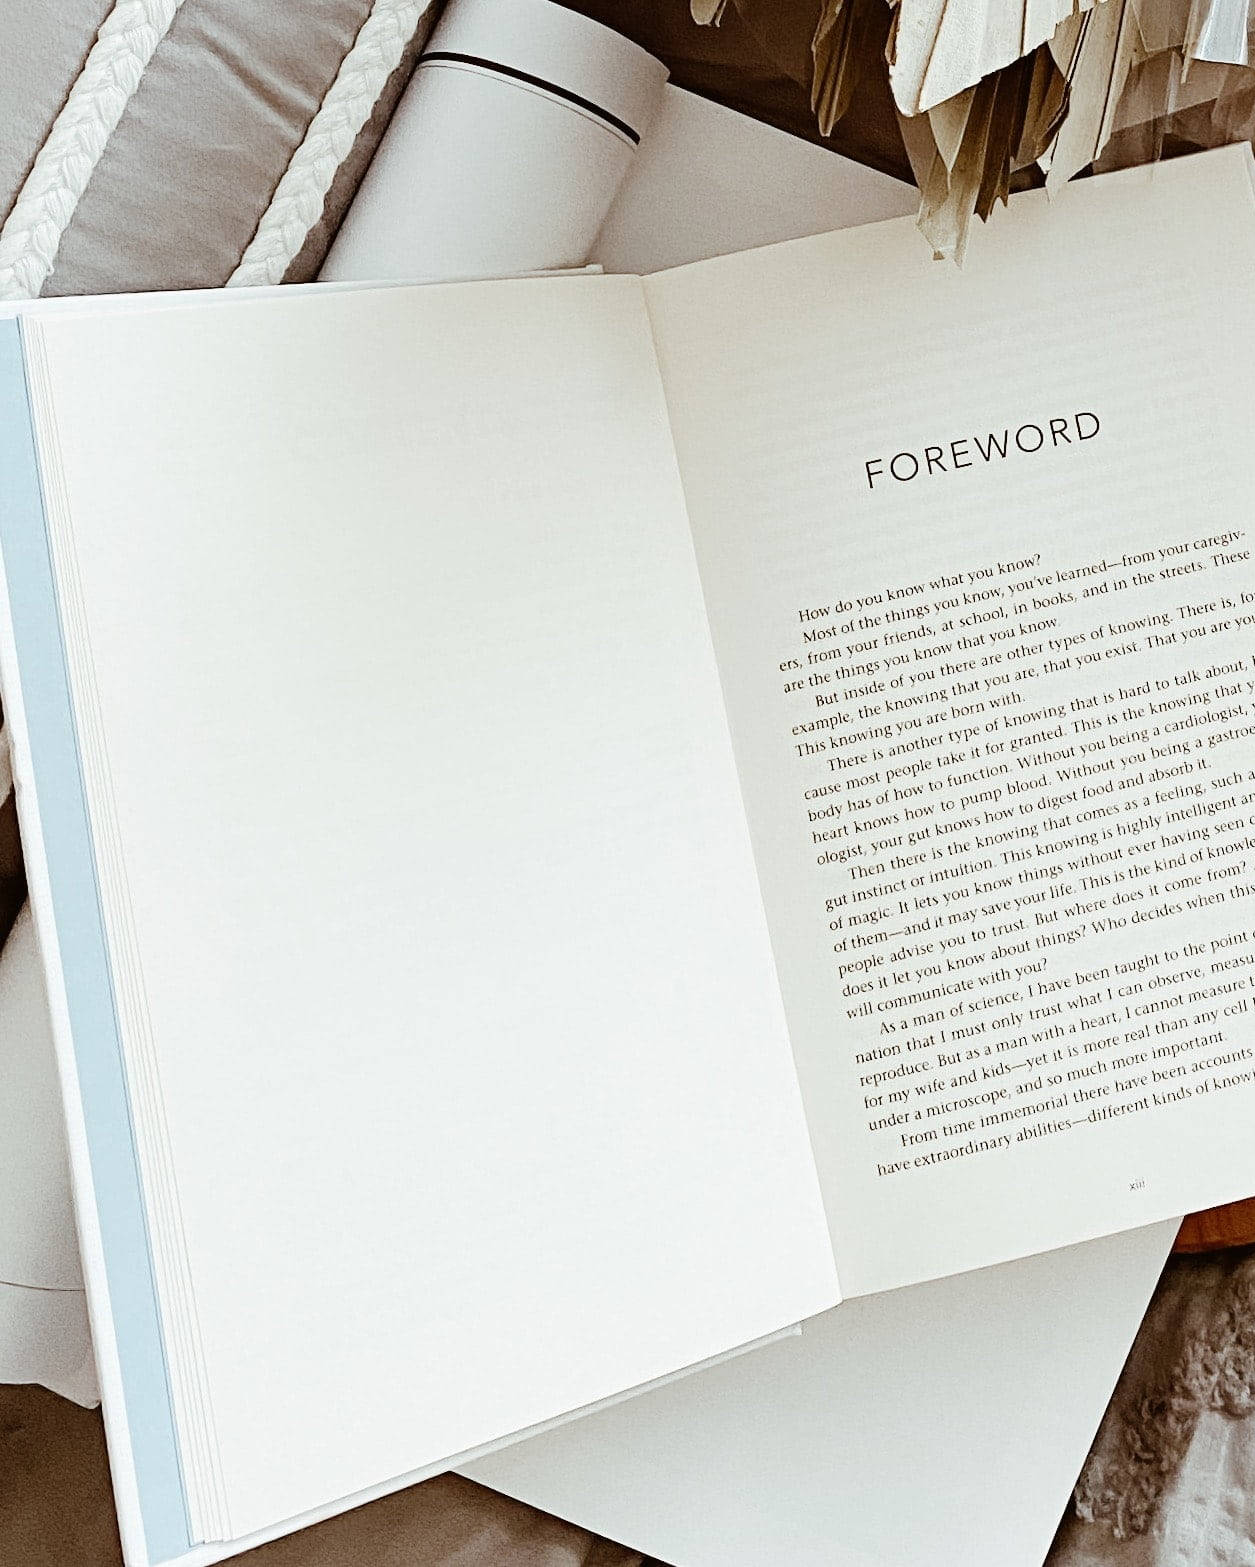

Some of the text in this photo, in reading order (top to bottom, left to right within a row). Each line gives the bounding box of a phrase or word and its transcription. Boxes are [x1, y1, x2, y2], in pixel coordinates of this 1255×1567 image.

[865, 412, 1100, 488] FOREWORD
[798, 553, 1041, 624] How do you know what you know?
[807, 647, 843, 666] from
[845, 638, 880, 660] your
[940, 619, 955, 633] at
[1012, 601, 1030, 616] in
[1081, 580, 1110, 599] and
[1112, 576, 1129, 592] in
[1128, 571, 1156, 587] the
[1209, 550, 1251, 568] These
[814, 690, 840, 712] But
[842, 680, 887, 701] inside
[890, 673, 906, 690] of
[908, 669, 936, 689] you
[939, 658, 977, 677] there
[980, 653, 1003, 667] are
[1006, 640, 1046, 662] other
[1048, 633, 1088, 654] types
[1090, 625, 1105, 641] of
[1175, 601, 1218, 620] There
[794, 738, 827, 758] This
[828, 725, 894, 751] knowing
[895, 717, 923, 737] you
[926, 711, 948, 726] are
[950, 701, 986, 720] born
[804, 782, 843, 801] cause
[845, 771, 882, 792] most
[885, 758, 933, 785] people
[936, 751, 967, 769] take
[969, 746, 982, 760] it
[985, 739, 1005, 756] for
[1070, 717, 1103, 737] This
[1105, 712, 1119, 726] is
[1121, 706, 1146, 723] the
[1148, 688, 1212, 717] knowing
[1214, 682, 1244, 699] that
[807, 801, 844, 827] body
[846, 797, 873, 813] has
[874, 789, 892, 807] of
[893, 783, 925, 801] how
[928, 780, 944, 793] to
[1016, 745, 1077, 770] Without
[1079, 739, 1107, 759] you
[1108, 728, 1151, 749] being
[825, 893, 849, 914] gut
[851, 878, 908, 904] instinct
[910, 875, 927, 888] or
[999, 847, 1033, 866] This
[1035, 832, 1100, 857] knowing
[1101, 825, 1114, 841] is
[1116, 814, 1162, 839] highly
[1165, 796, 1237, 825] intelligent
[870, 835, 904, 857] your
[906, 826, 933, 847] gut
[934, 815, 982, 837] knows
[983, 806, 1016, 825] how
[1018, 801, 1034, 816] to
[1037, 788, 1079, 813] digest
[1082, 779, 1115, 800] food
[1117, 771, 1145, 791] and
[1147, 761, 1194, 783] absorb
[829, 915, 844, 932] of
[897, 899, 910, 916] It
[913, 892, 941, 911] lets
[941, 887, 970, 909] you
[973, 876, 1014, 896] know
[1018, 863, 1064, 885] things
[1067, 847, 1124, 872] without
[1127, 840, 1157, 857] ever
[1159, 825, 1211, 848] having
[1213, 818, 1245, 836] seen
[841, 979, 875, 998] does
[877, 976, 890, 990] it
[891, 970, 912, 986] let
[913, 963, 943, 985] you
[945, 952, 986, 973] know
[990, 938, 1032, 961] about
[1035, 923, 1087, 952] things?
[1090, 916, 1128, 934] Who
[1131, 902, 1183, 925] decides
[1186, 889, 1226, 910] when
[846, 957, 1048, 1020] will communicate with you?
[855, 1044, 903, 1065] nation
[906, 1032, 937, 1054] that
[950, 1021, 988, 1042] must
[991, 1011, 1024, 1033] only
[1029, 1002, 1064, 1021] trust
[1066, 992, 1103, 1010] what
[1117, 982, 1145, 998] can
[868, 1111, 911, 1132] under
[1015, 1075, 1044, 1095] and
[1046, 1074, 1063, 1088] so
[1066, 1060, 1109, 1082] much
[1111, 1052, 1149, 1071] more
[900, 1129, 939, 1148] From
[941, 1119, 977, 1138] time
[979, 1092, 1069, 1129] immemorial
[1073, 1085, 1111, 1104] there
[1113, 1071, 1149, 1094] have
[1151, 1065, 1188, 1083] been
[1191, 1048, 1254, 1073] accounts
